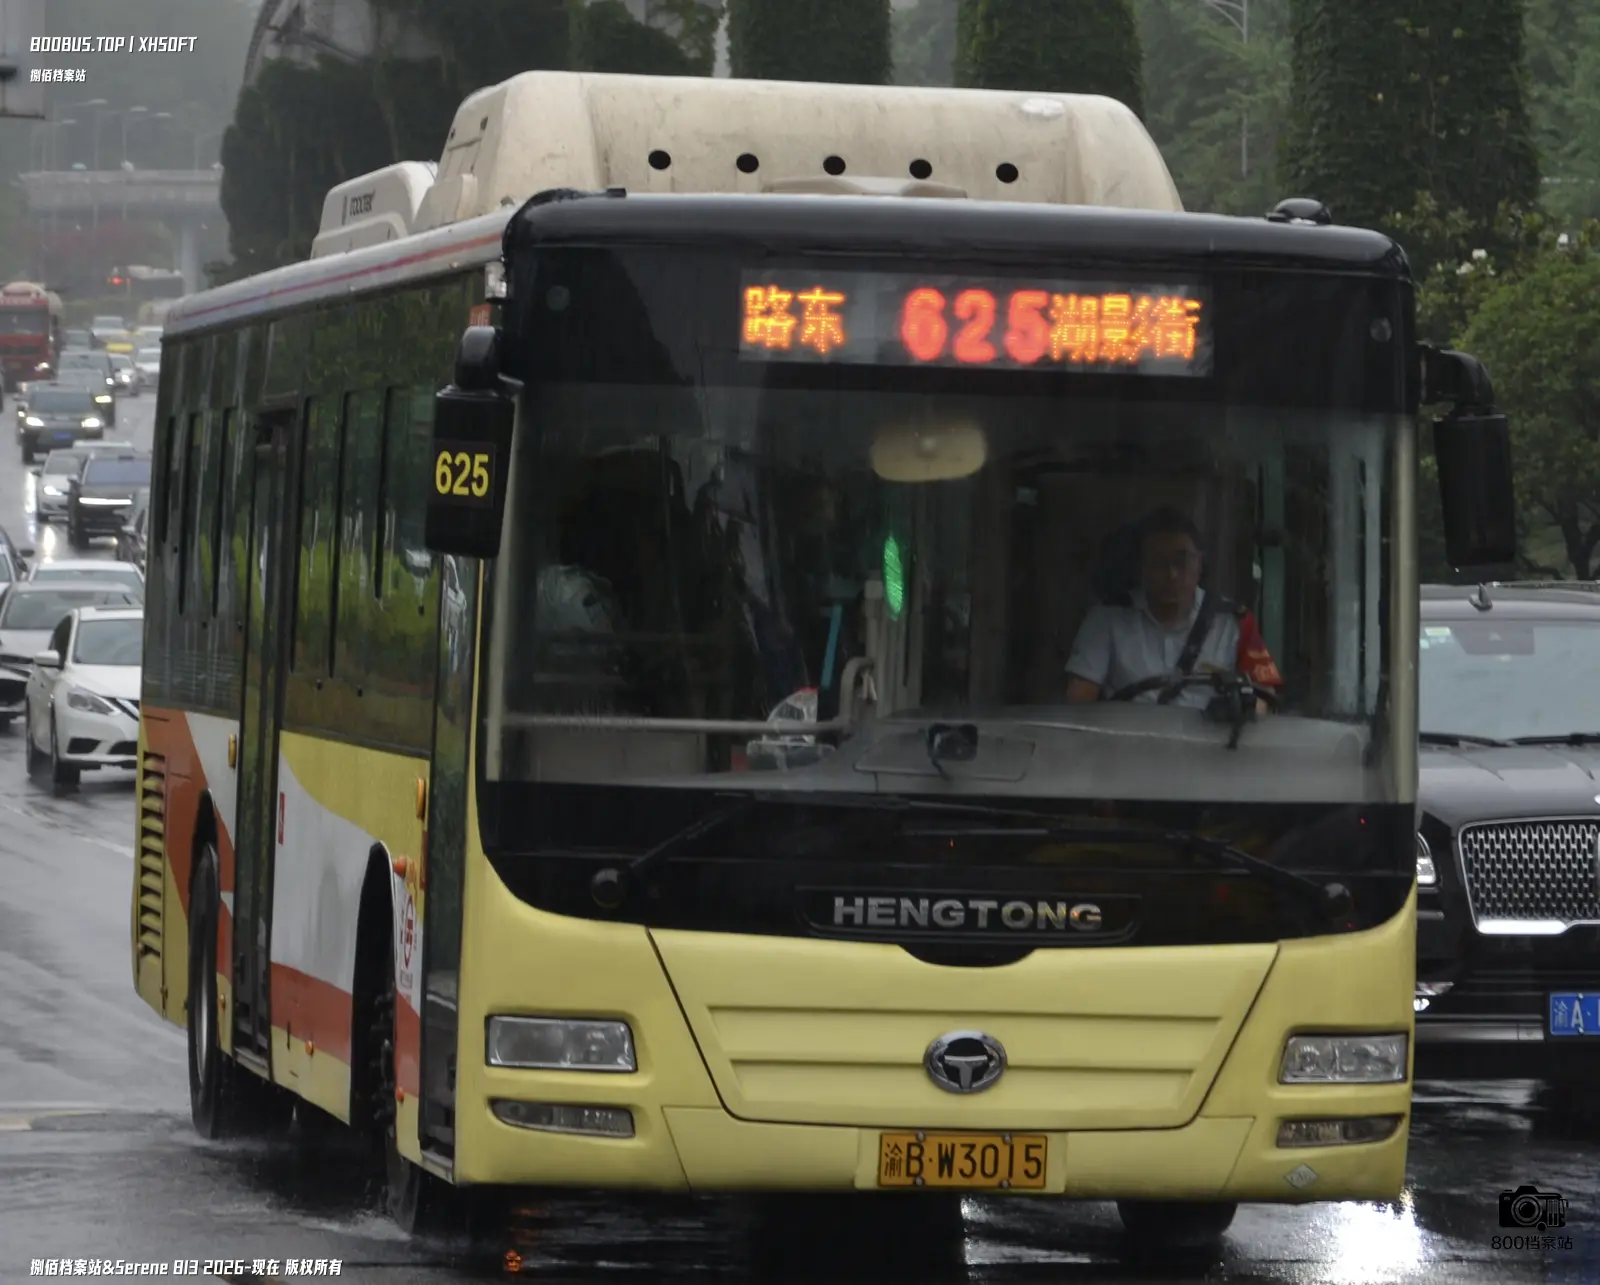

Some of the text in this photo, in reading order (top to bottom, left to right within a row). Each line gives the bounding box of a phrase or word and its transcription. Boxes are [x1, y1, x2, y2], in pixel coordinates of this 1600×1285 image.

[901, 287, 1050, 362] 625
[1050, 293, 1201, 363] 湖影街
[435, 450, 489, 497] 625
[833, 896, 1103, 931] HENGTONG
[1553, 999, 1600, 1029] 渝A·
